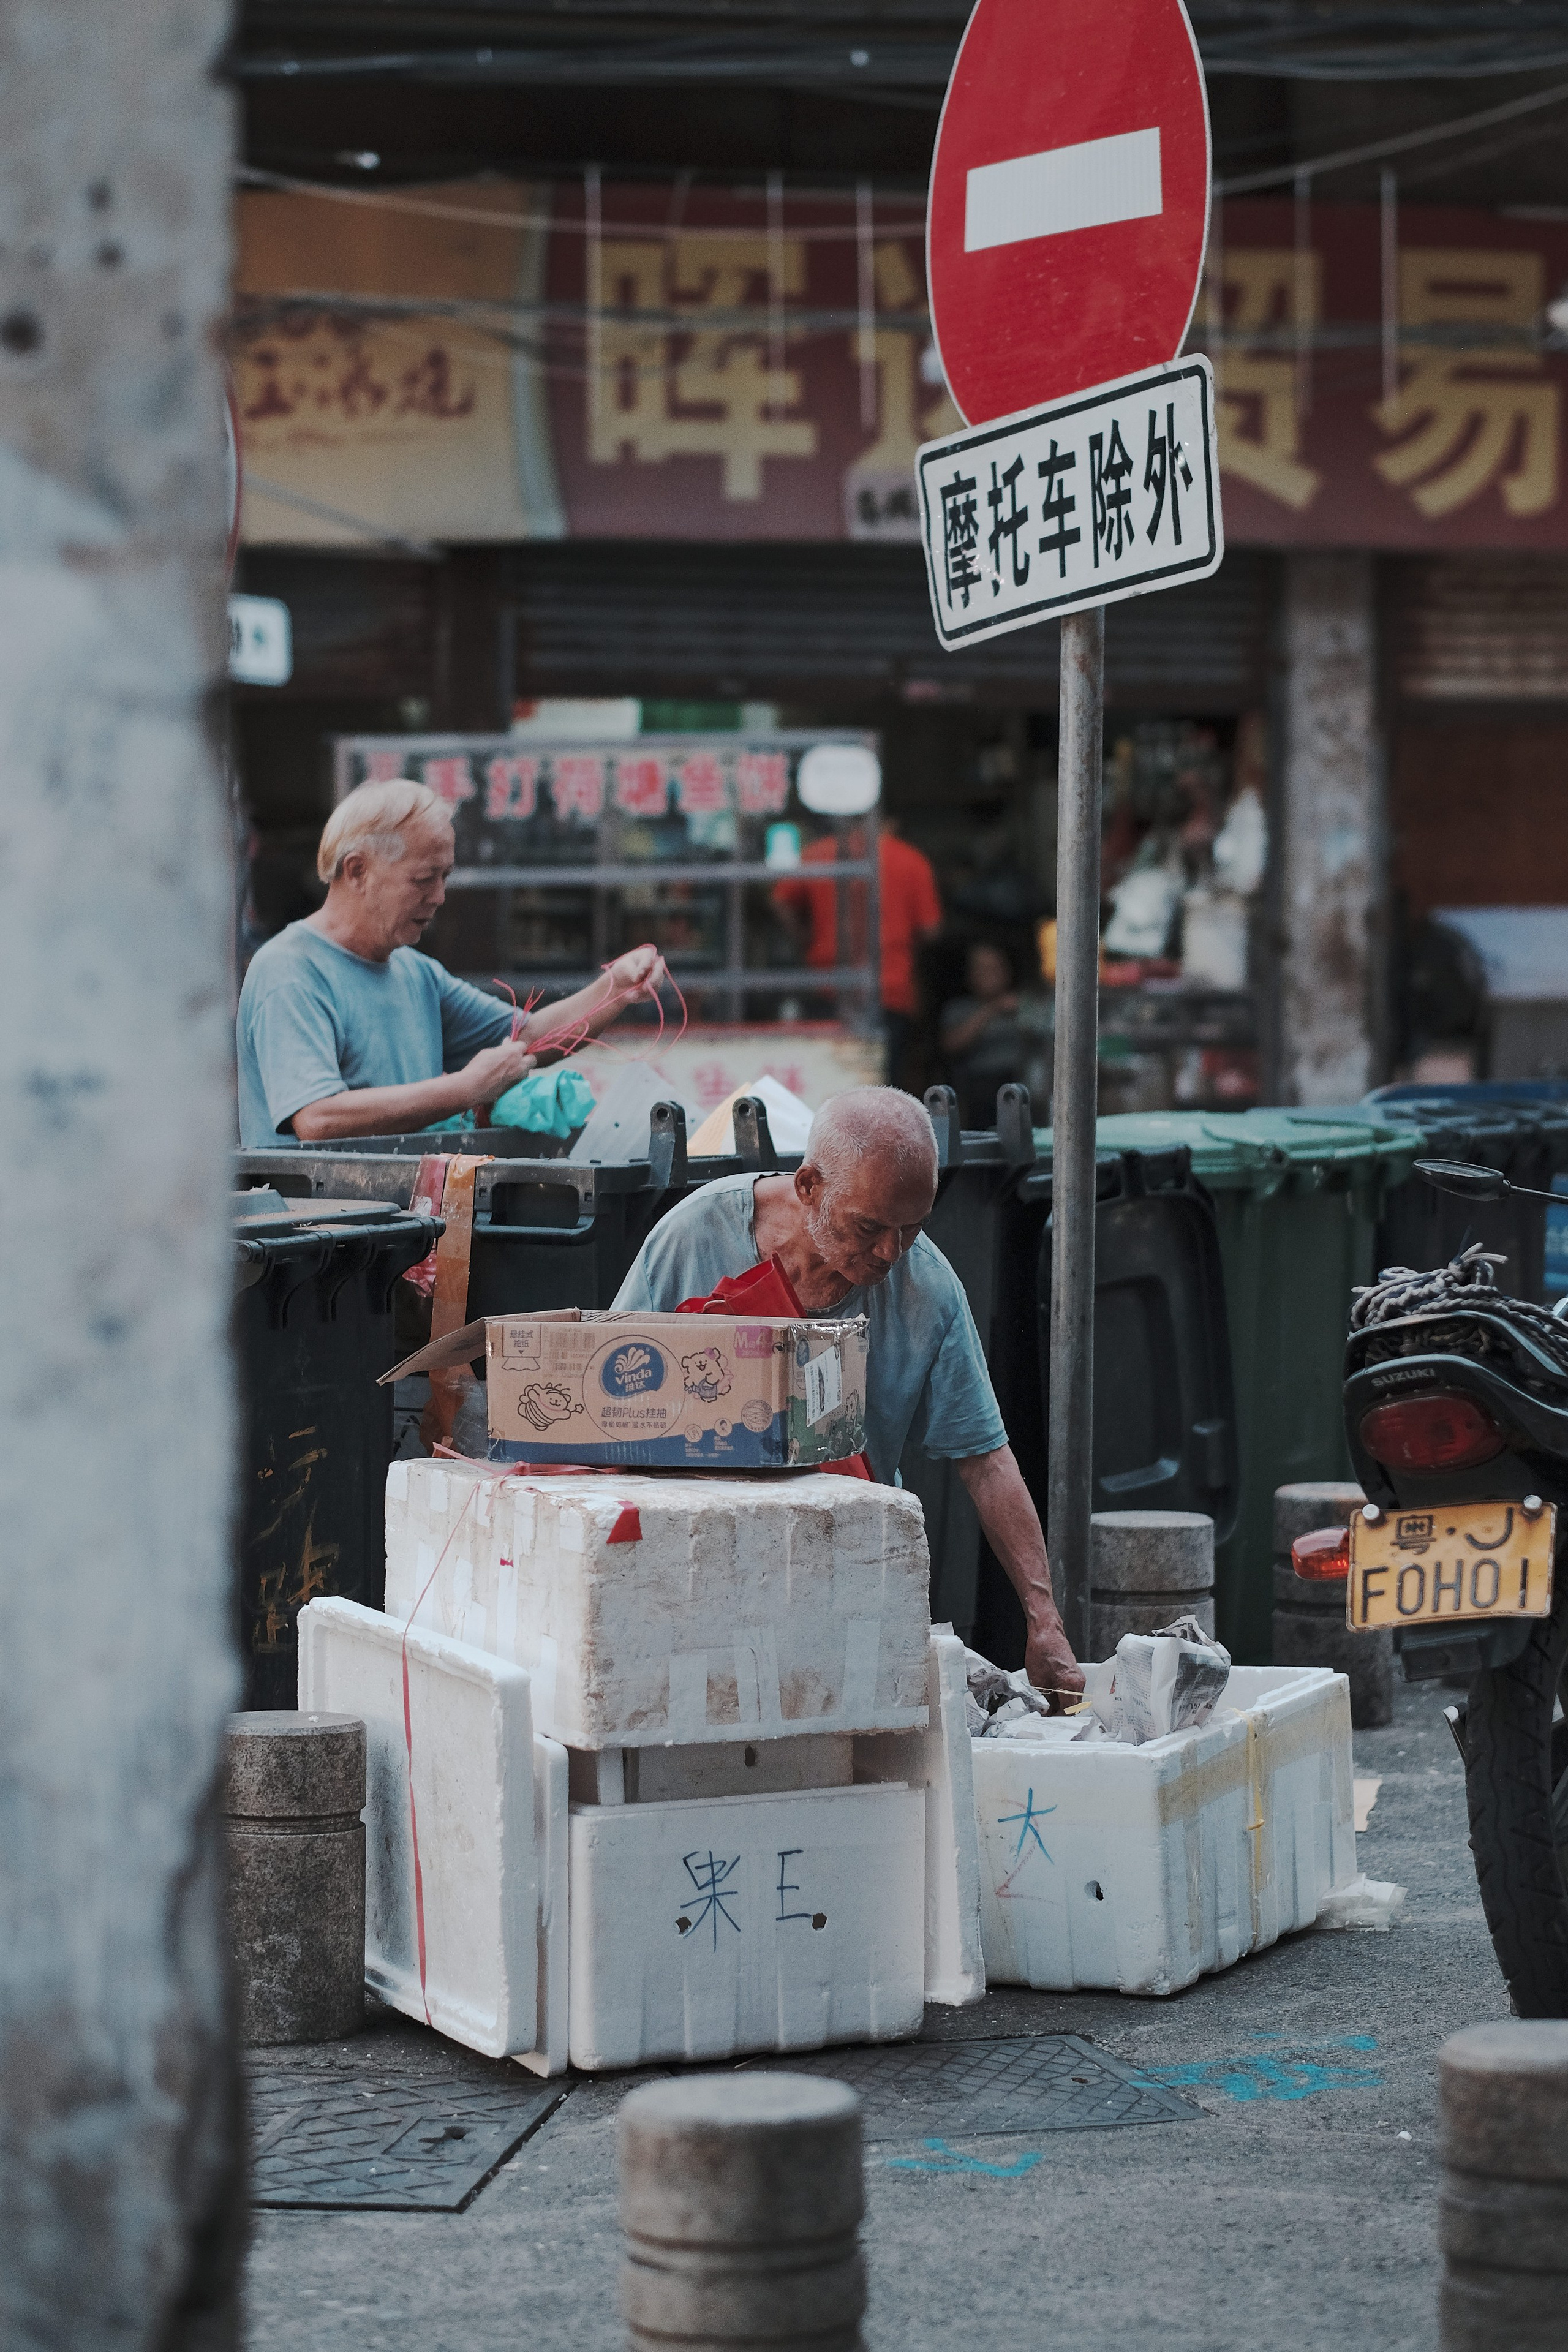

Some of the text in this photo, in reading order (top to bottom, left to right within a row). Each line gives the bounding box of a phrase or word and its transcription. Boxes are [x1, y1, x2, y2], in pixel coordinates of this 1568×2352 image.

[940, 402, 1193, 611] 摩托车除外
[1371, 1368, 1436, 1387] SUZUKI
